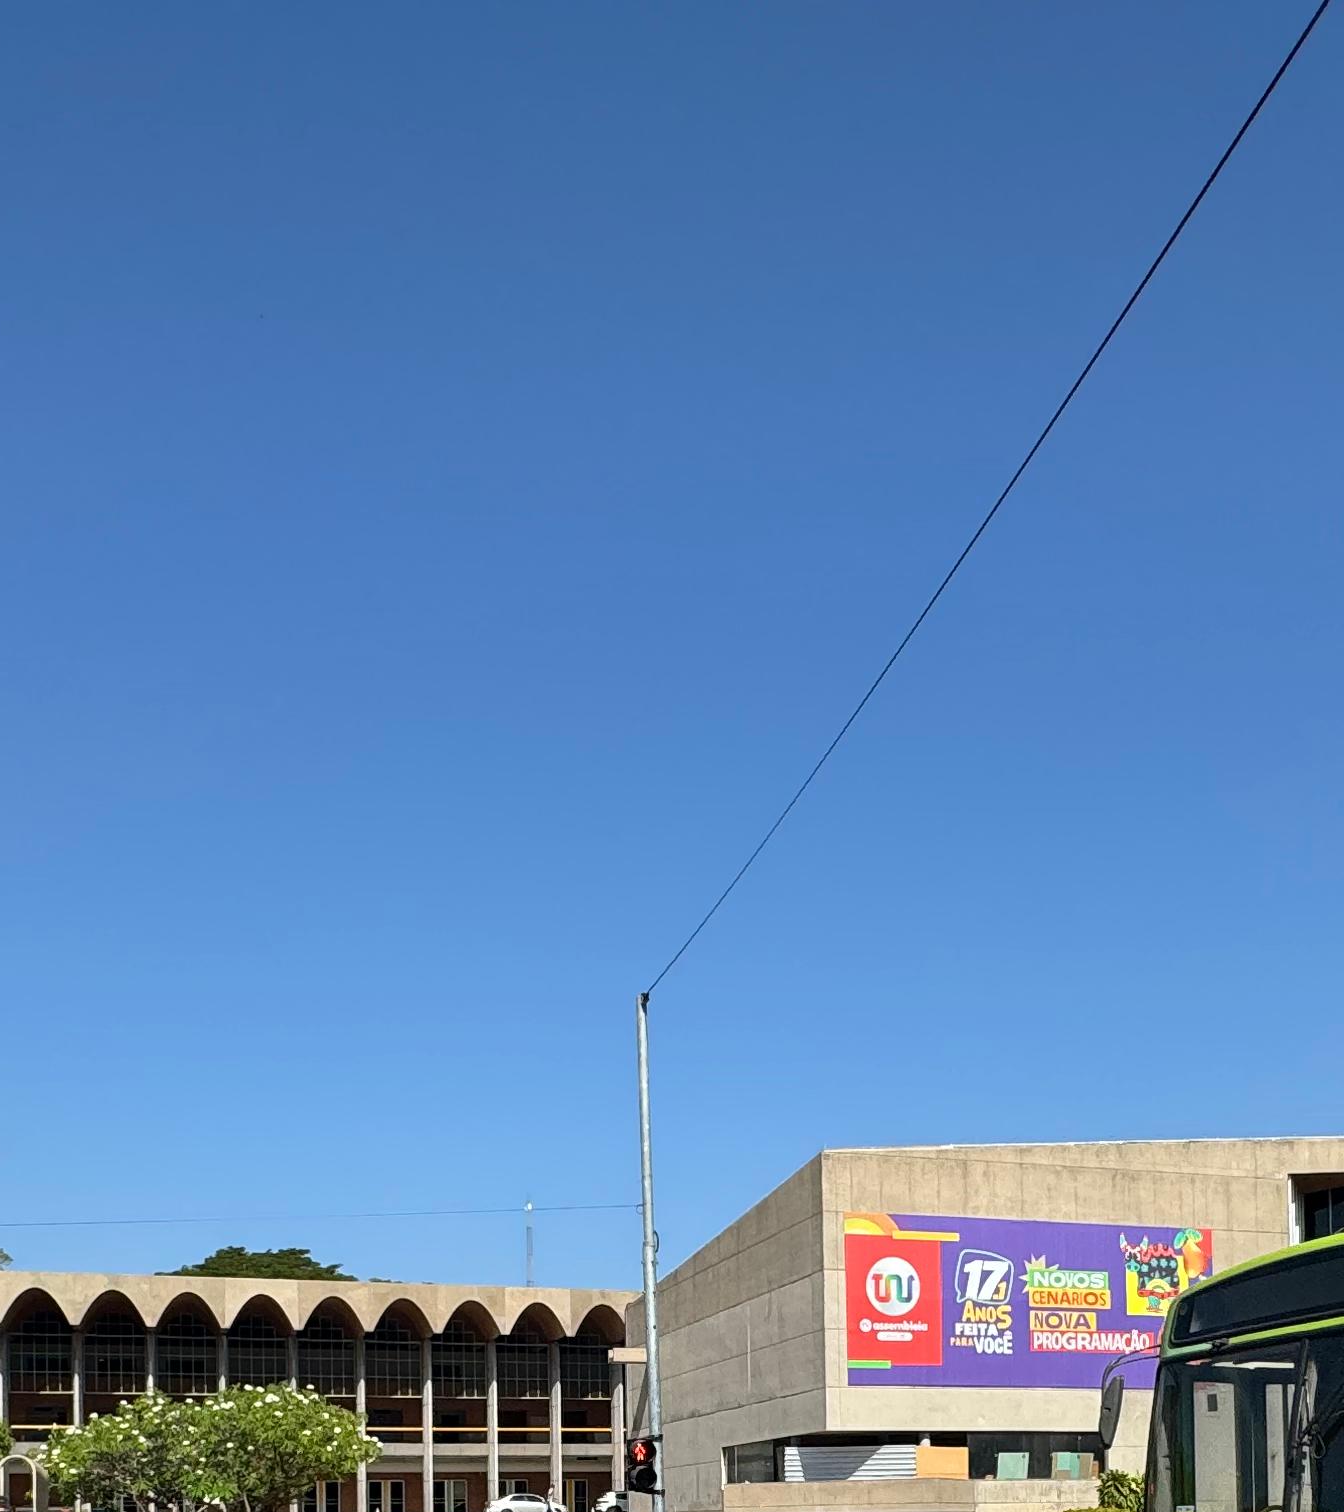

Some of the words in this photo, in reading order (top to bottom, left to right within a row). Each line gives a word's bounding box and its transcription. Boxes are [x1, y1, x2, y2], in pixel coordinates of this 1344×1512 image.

[1033, 1271, 1105, 1289] NOVOS
[962, 1301, 1011, 1329] ANOS
[1034, 1312, 1092, 1329] NOVA
[955, 1323, 998, 1336] FEITA
[950, 1337, 974, 1346] PARA
[974, 1330, 1013, 1354] VOCÊ
[1033, 1329, 1150, 1354] PROGRAMAÇÃO
